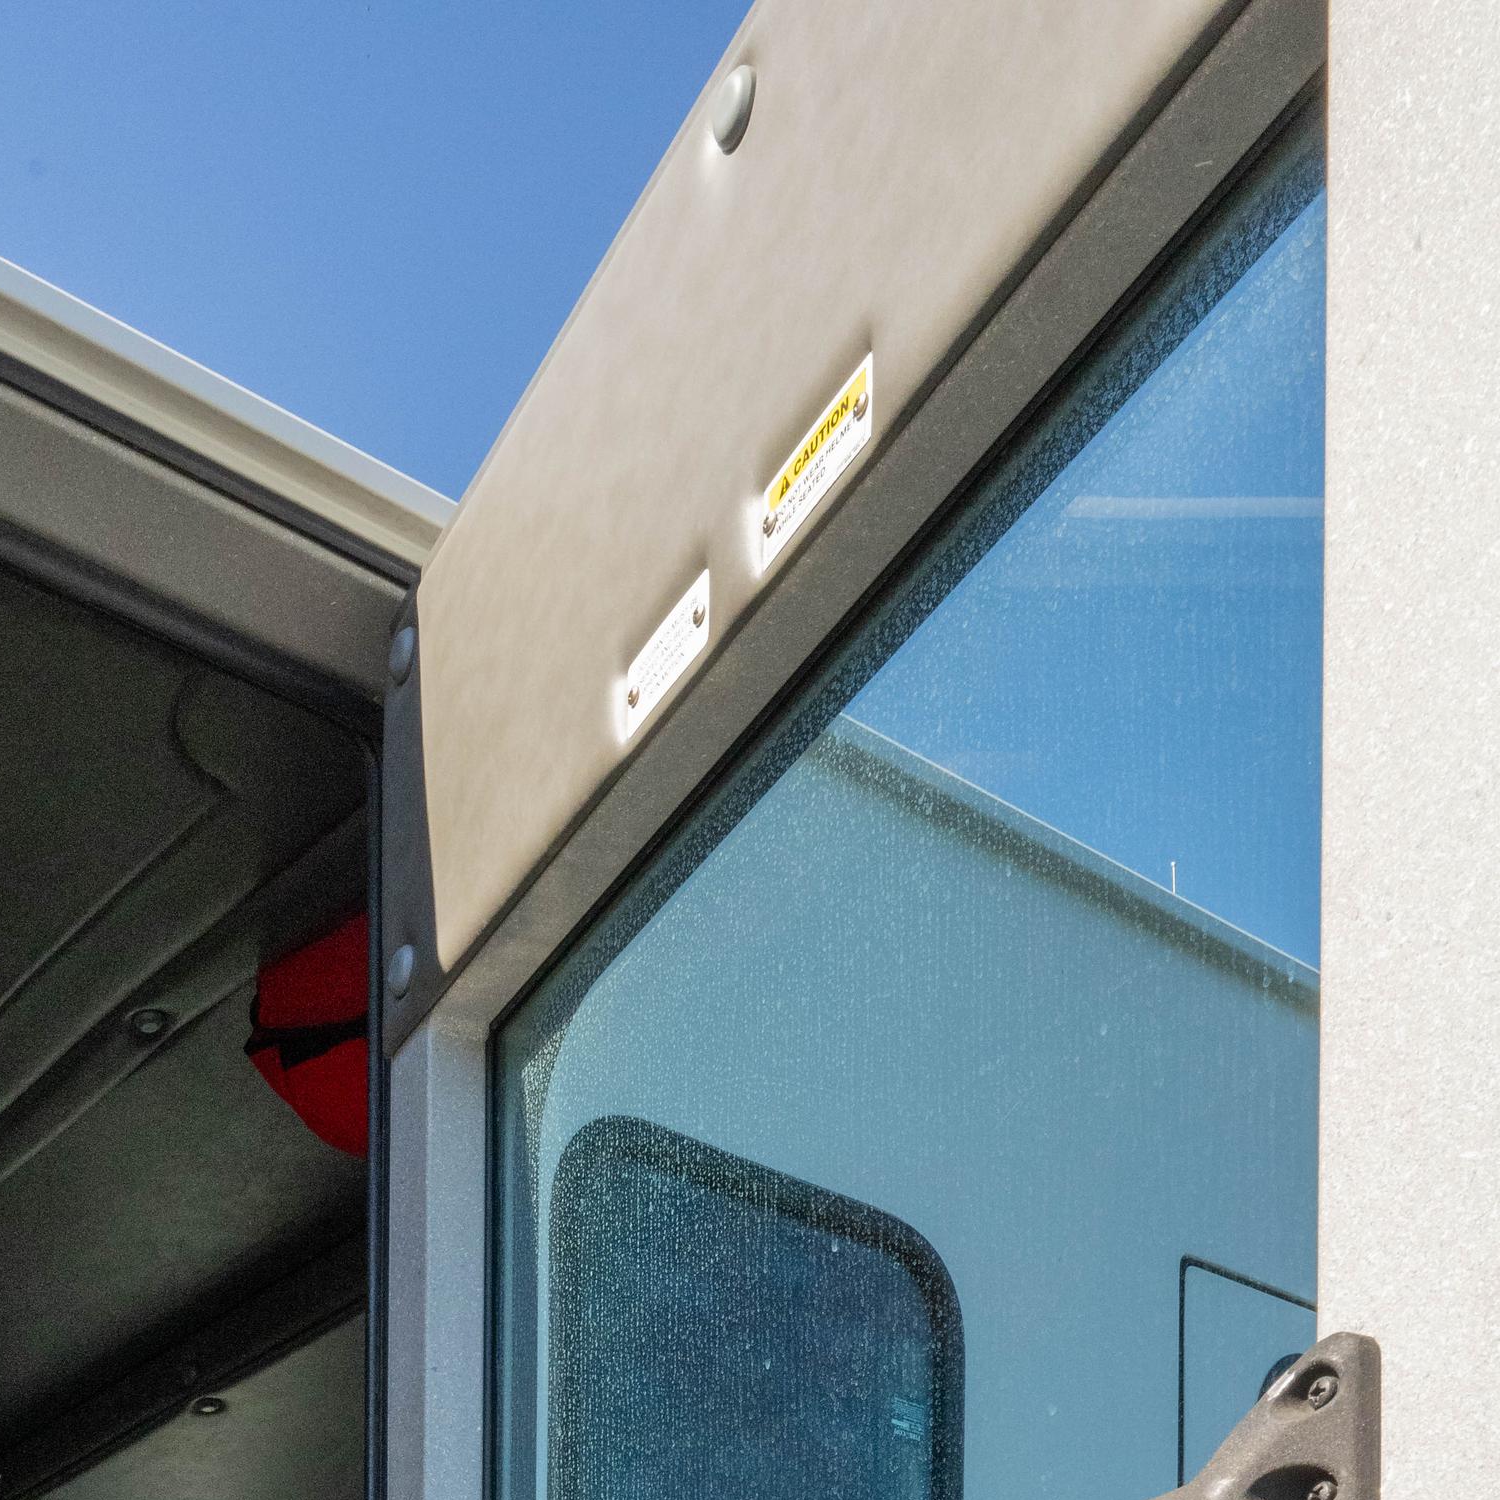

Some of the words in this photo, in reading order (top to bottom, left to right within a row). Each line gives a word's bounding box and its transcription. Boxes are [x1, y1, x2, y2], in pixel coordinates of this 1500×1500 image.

[794, 396, 848, 474] CAUTION
[776, 506, 796, 534] WHILE
[799, 465, 826, 506] SEATED
[788, 483, 800, 506] NOT
[803, 453, 824, 485] WEAR
